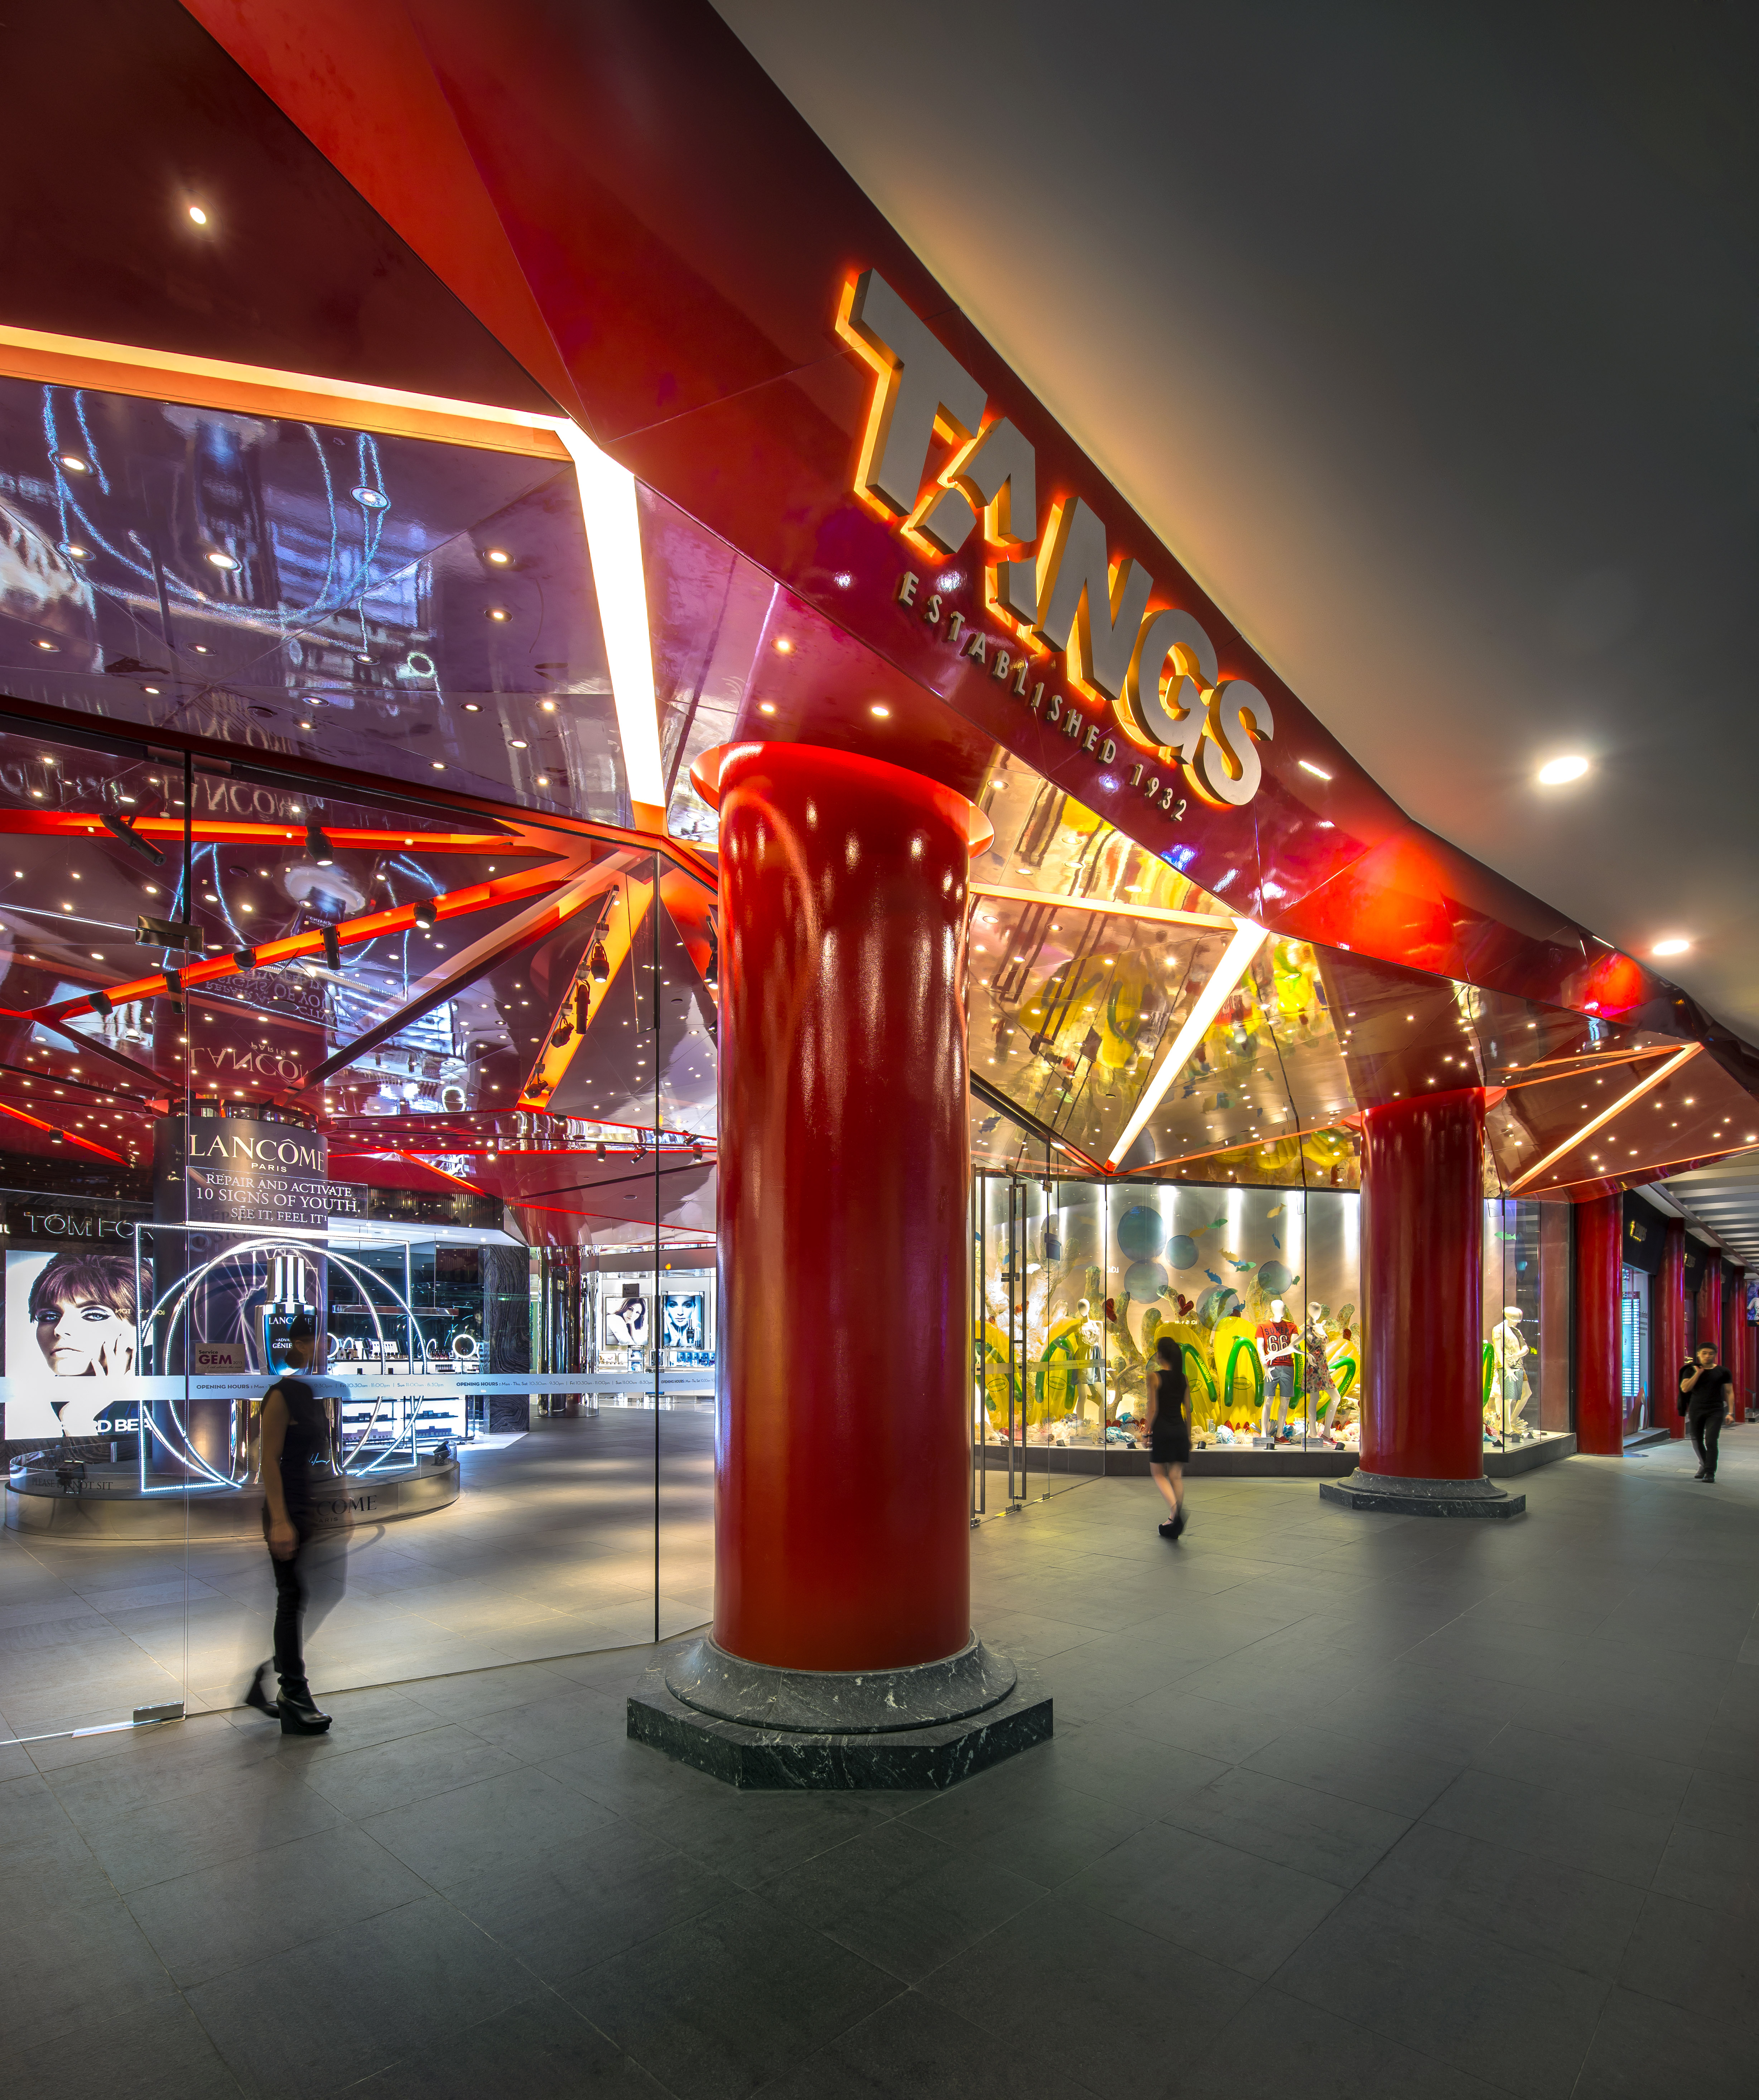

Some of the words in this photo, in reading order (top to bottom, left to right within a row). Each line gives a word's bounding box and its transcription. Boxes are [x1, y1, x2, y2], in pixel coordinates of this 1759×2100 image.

[837, 268, 1273, 805] TANGS
[899, 571, 1116, 763] ESTABLISHED
[1129, 764, 1186, 821] 1932
[189, 1134, 325, 1172] LANCÔME
[251, 1163, 287, 1172] PARIS
[206, 1174, 255, 1188] REPAIR
[257, 1179, 288, 1191] AND
[290, 1182, 352, 1197] ACTIVATE
[197, 1187, 213, 1200] 10
[219, 1188, 269, 1205] SIGNS
[274, 1193, 296, 1207] OF
[299, 1196, 360, 1212] YOUTH.
[24, 1212, 92, 1236] TOM
[231, 1207, 255, 1219] SEE
[258, 1210, 274, 1221] IT,
[277, 1211, 307, 1223] FEEL
[269, 1316, 312, 1325] LANCE
[1264, 1326, 1289, 1335] SUPER
[1267, 1334, 1289, 1352] 66
[198, 1354, 232, 1365] GEM
[1196, 1355, 1213, 1383] havaianas
[32, 1477, 55, 1487] PLEASE
[73, 1480, 94, 1490] NOT
[97, 1481, 113, 1490] SIT
[316, 1495, 377, 1516] CÔME
